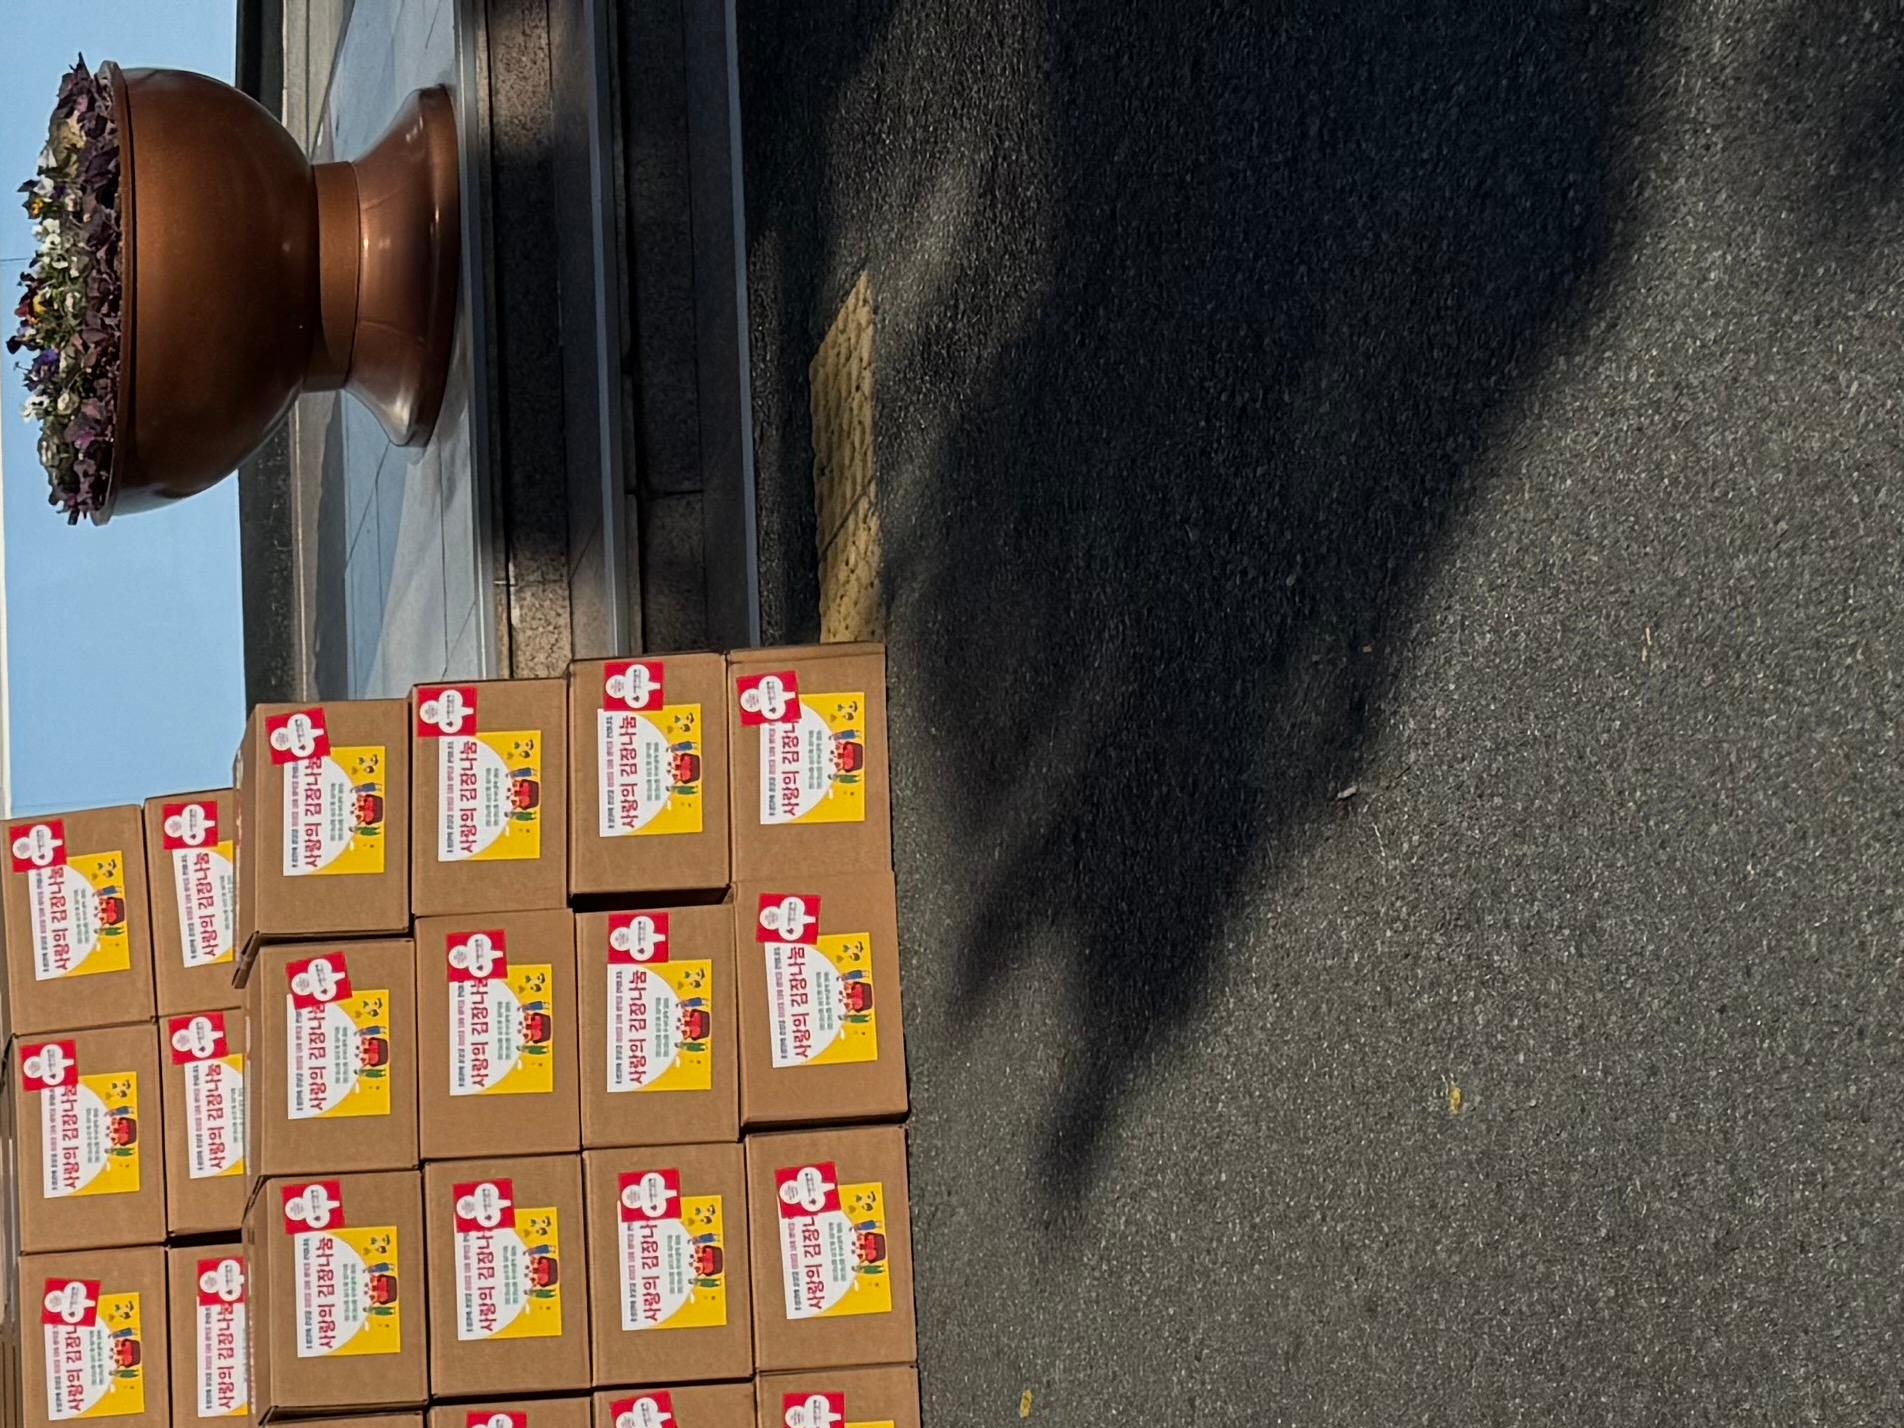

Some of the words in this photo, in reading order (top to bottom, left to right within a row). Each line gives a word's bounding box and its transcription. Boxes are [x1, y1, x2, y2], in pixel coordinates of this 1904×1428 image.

[620, 715, 636, 776] 김장나눔
[304, 758, 321, 816] 김장나눔
[460, 741, 476, 801] 김장나눔
[783, 771, 799, 816] 사랑의
[621, 783, 637, 828] 사랑의
[305, 823, 321, 867] 사랑의
[461, 808, 477, 853] 사랑의
[50, 867, 67, 922] 김장나눔
[196, 853, 213, 909] 김장나눔
[54, 928, 71, 970] 사랑의
[201, 915, 218, 956] 사랑의
[791, 947, 808, 1006] 김장나눔
[630, 970, 646, 1033] 김장나눔
[794, 1014, 810, 1058] 사랑의
[473, 1042, 489, 1087] 사랑의
[630, 1041, 647, 1084] 사랑의
[206, 1064, 223, 1120] 김장나눔
[310, 1067, 326, 1110] 사랑의
[63, 1147, 79, 1189] 사랑의
[208, 1127, 224, 1169] 사랑의
[317, 1238, 334, 1297] 김장나눔
[807, 1264, 825, 1309] 사랑의
[479, 1288, 496, 1331] 사랑의
[643, 1277, 659, 1321] 사랑의
[319, 1304, 335, 1348] 사랑의
[67, 1369, 84, 1411] 사랑의
[217, 1367, 234, 1408] 사랑의
